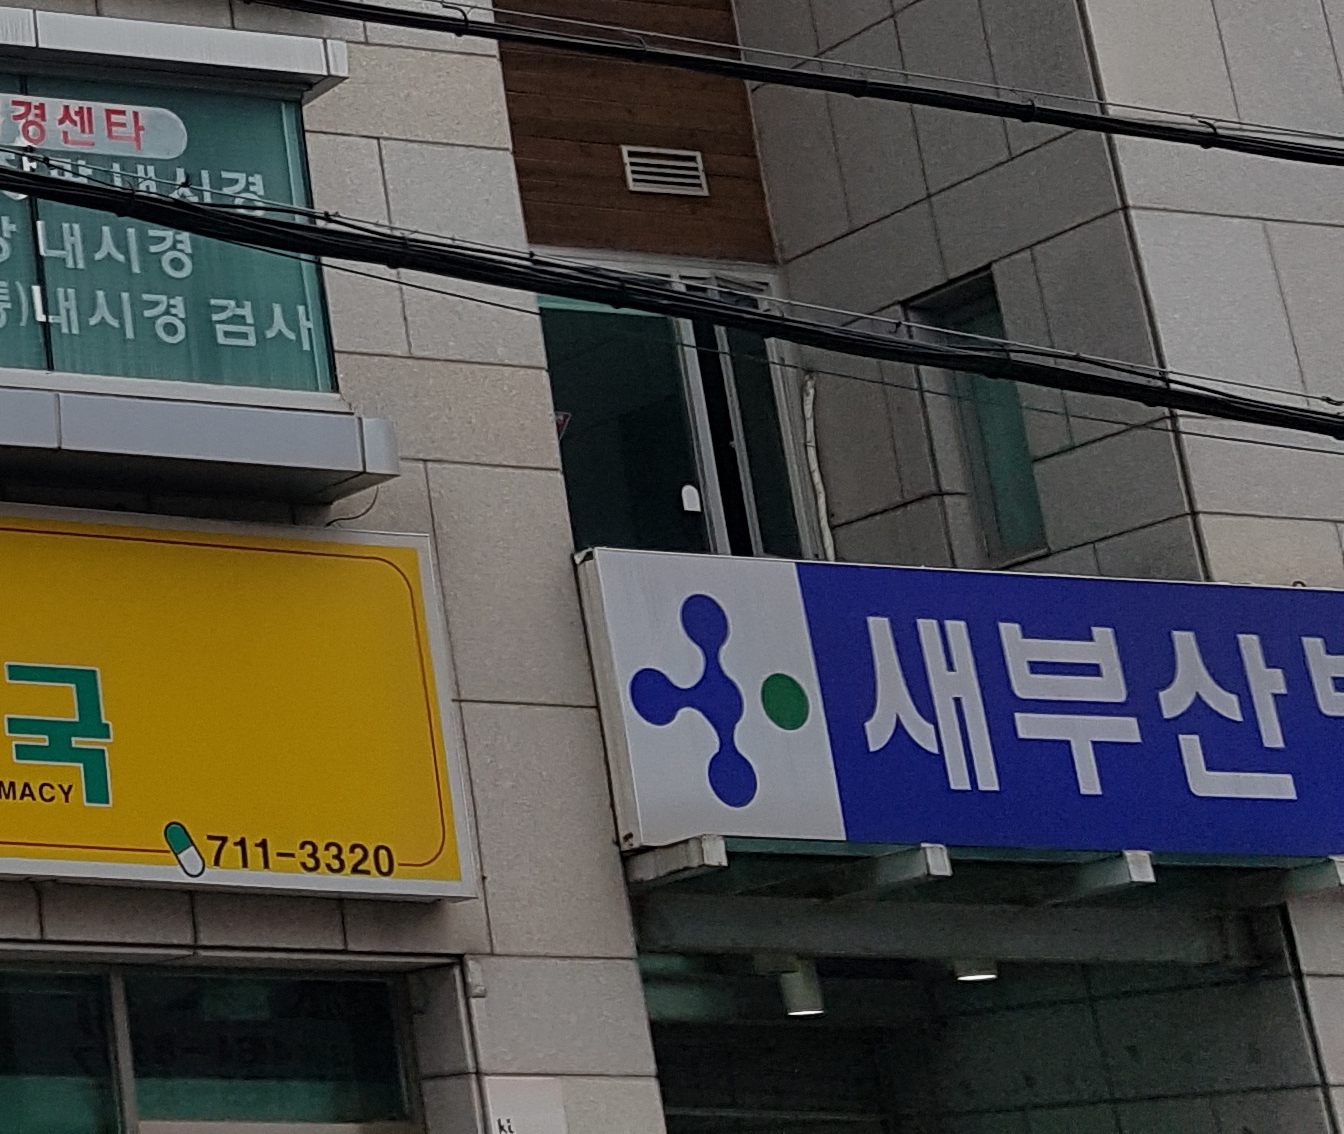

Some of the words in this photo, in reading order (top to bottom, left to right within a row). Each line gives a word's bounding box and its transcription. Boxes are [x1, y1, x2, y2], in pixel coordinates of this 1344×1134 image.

[36, 220, 195, 280] 내시경
[211, 298, 313, 351] 검사
[206, 834, 395, 877] 711-3320
